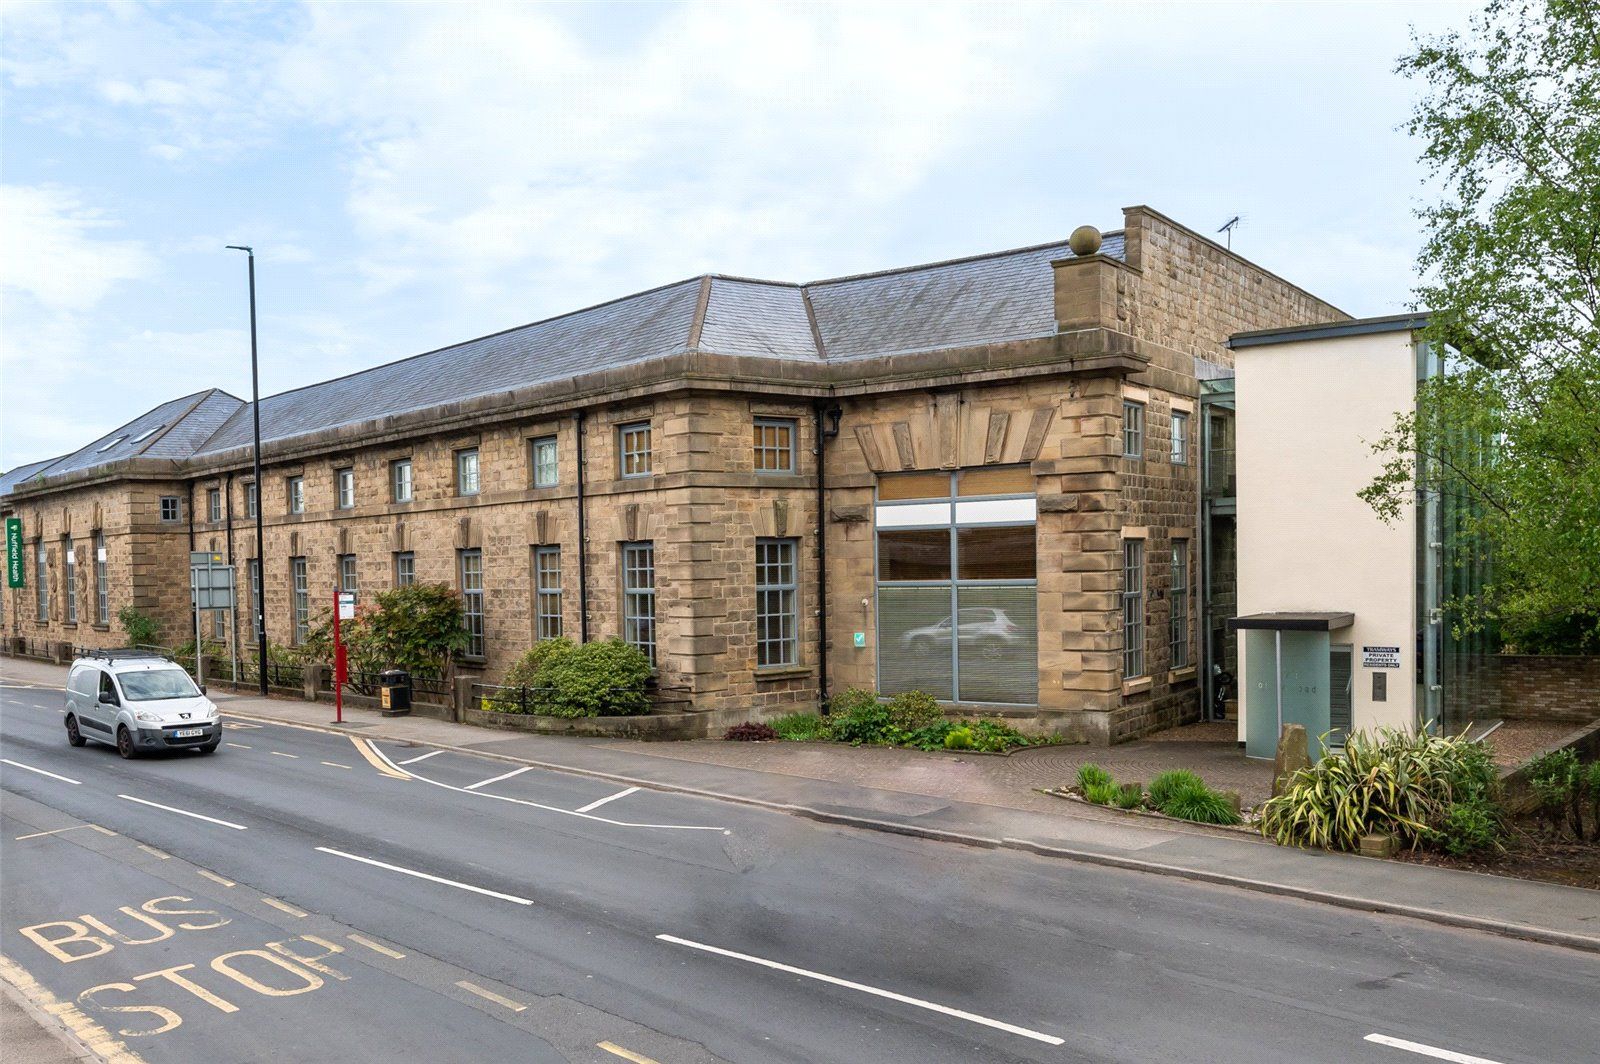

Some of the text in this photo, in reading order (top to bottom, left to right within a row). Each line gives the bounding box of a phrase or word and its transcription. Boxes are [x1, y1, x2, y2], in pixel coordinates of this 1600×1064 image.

[11, 532, 20, 582] Nuffield Health
[18, 895, 233, 964] BUS
[77, 934, 352, 1037] STOP
